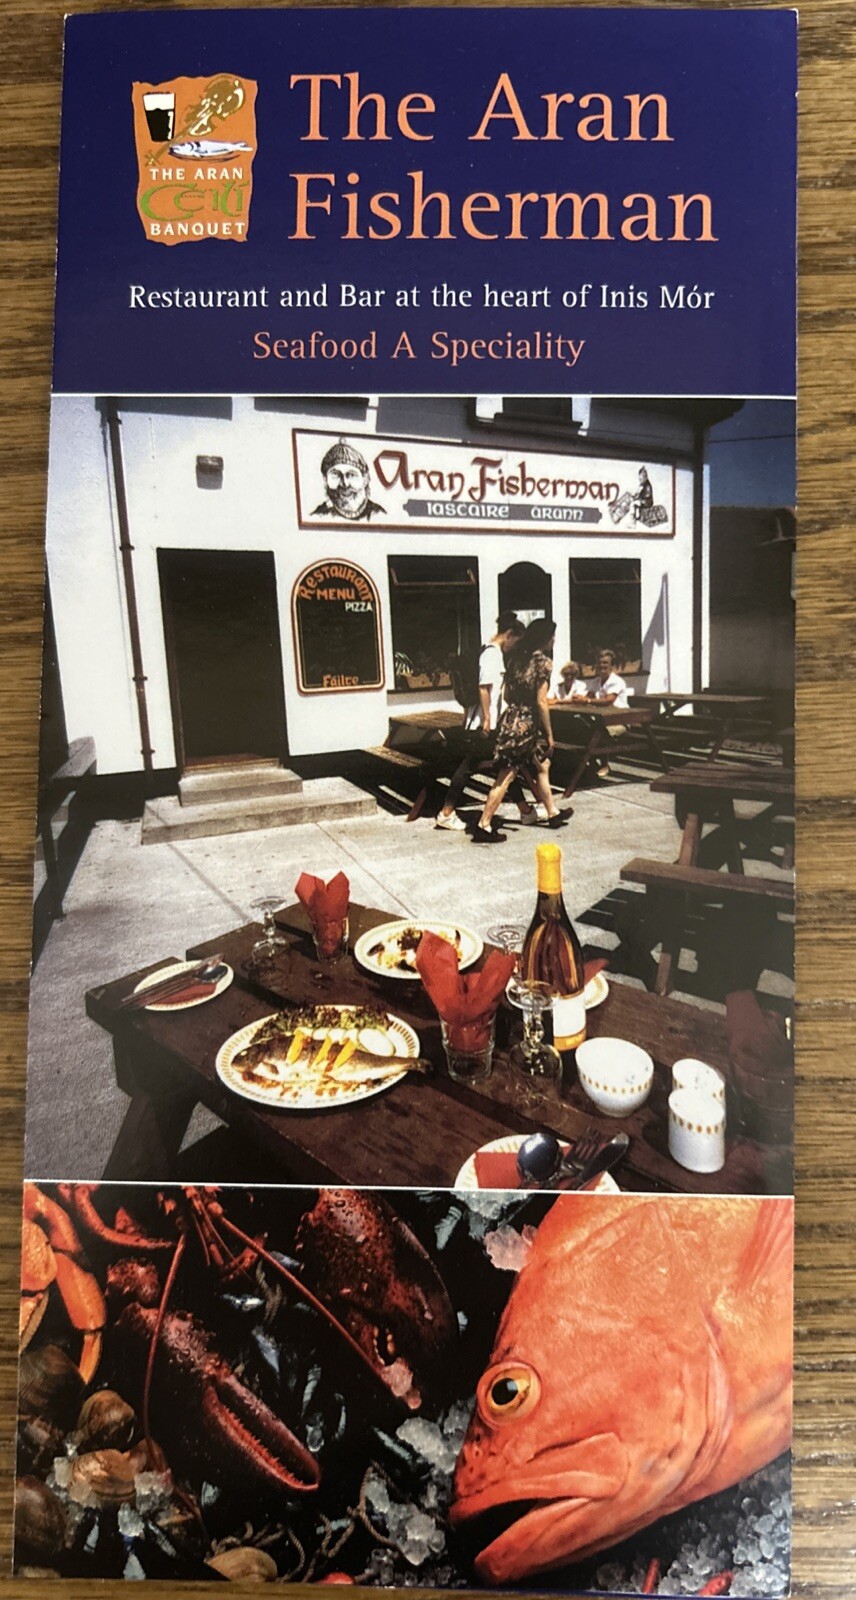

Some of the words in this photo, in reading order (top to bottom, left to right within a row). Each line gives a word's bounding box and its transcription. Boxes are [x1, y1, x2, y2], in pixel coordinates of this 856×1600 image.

[290, 71, 436, 141] The
[468, 73, 675, 142] Aran
[149, 167, 185, 181] THE
[194, 167, 243, 181] ARAN
[287, 170, 719, 242] Fisherman
[150, 221, 246, 237] BANQUET
[129, 285, 269, 308] Restaurant
[279, 284, 328, 307] and
[339, 284, 386, 307] Bar
[395, 286, 421, 307] at
[431, 284, 473, 308] the
[483, 284, 551, 308] heart
[562, 284, 593, 308] of
[600, 285, 648, 309] Inis
[659, 284, 715, 309] Mór
[253, 330, 377, 360] Seafood
[391, 332, 417, 360] A
[431, 330, 586, 367] Speciality
[373, 449, 466, 500] Aran
[467, 456, 620, 506] Fisherman
[316, 588, 356, 601] MENU
[344, 601, 374, 613] PIZZA
